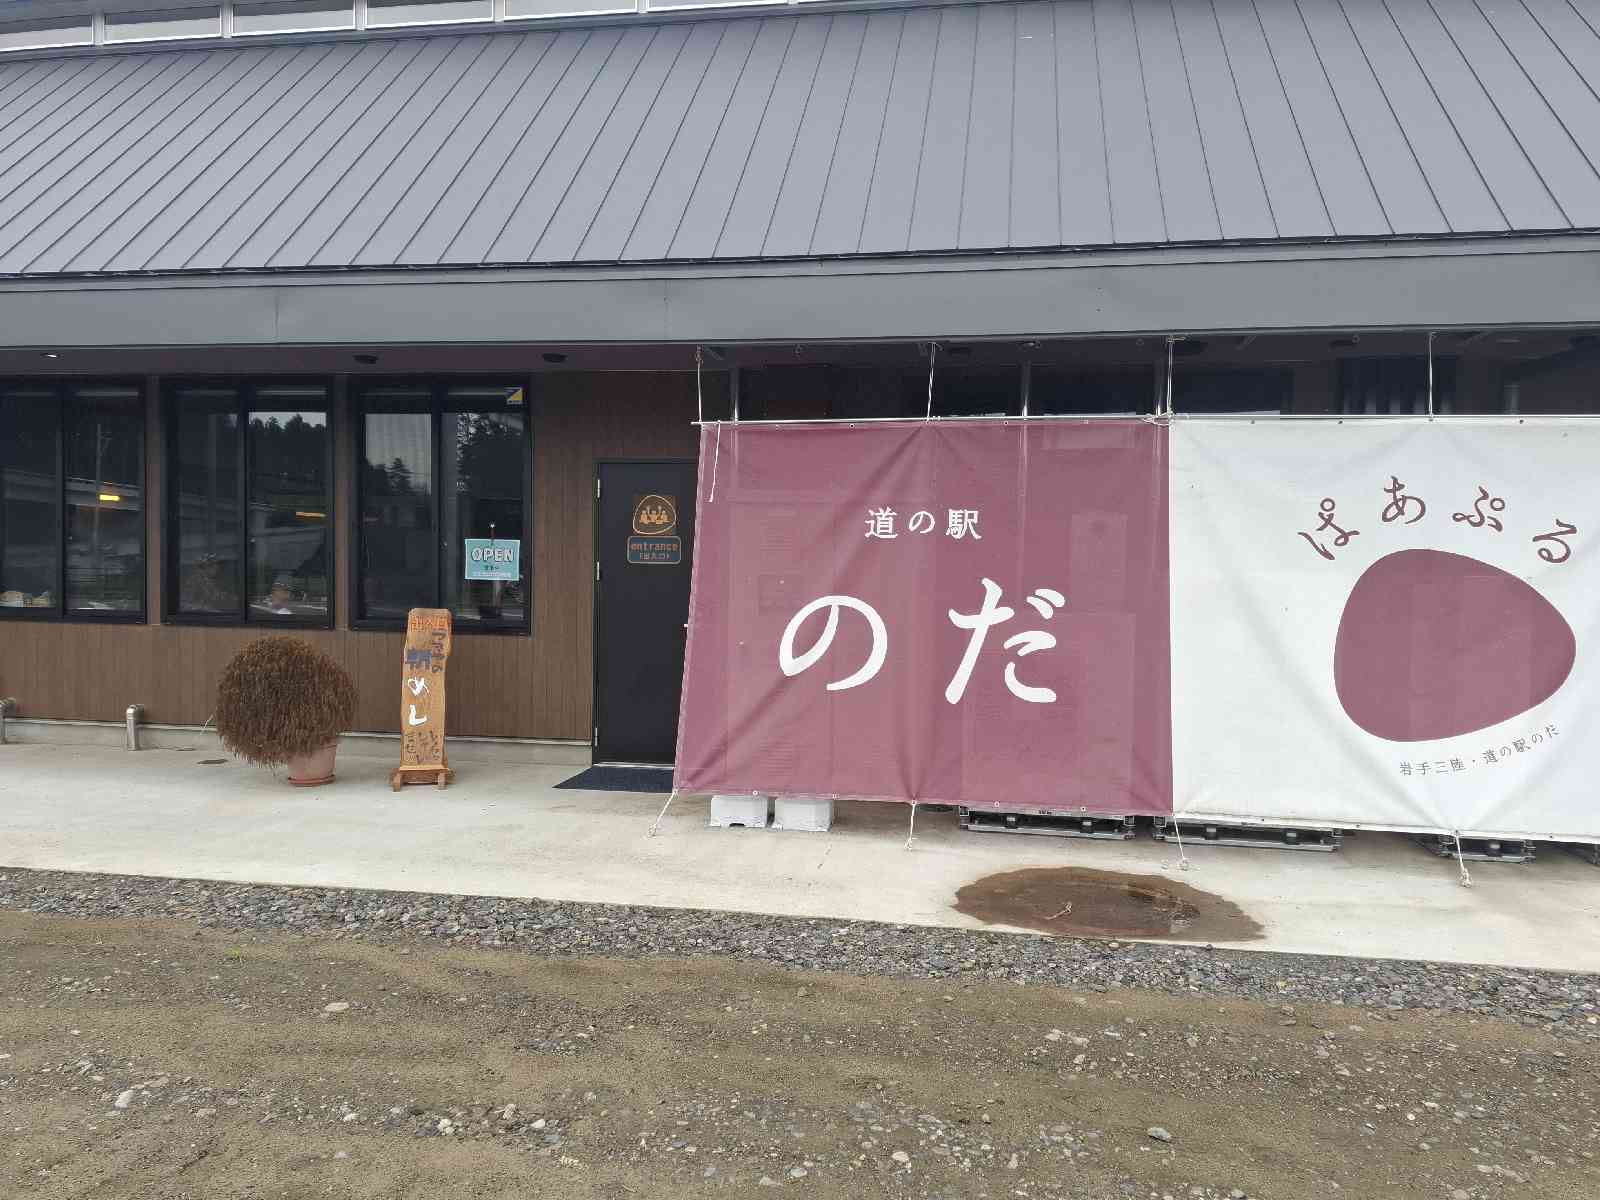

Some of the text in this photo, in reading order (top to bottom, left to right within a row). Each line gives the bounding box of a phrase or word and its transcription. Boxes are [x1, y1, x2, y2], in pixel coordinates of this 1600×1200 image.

[864, 507, 982, 540] 道の駅
[1297, 476, 1577, 563] ぱあぷる
[471, 547, 514, 562] OPEN
[630, 541, 680, 551] entrance
[779, 577, 1066, 705] のだ
